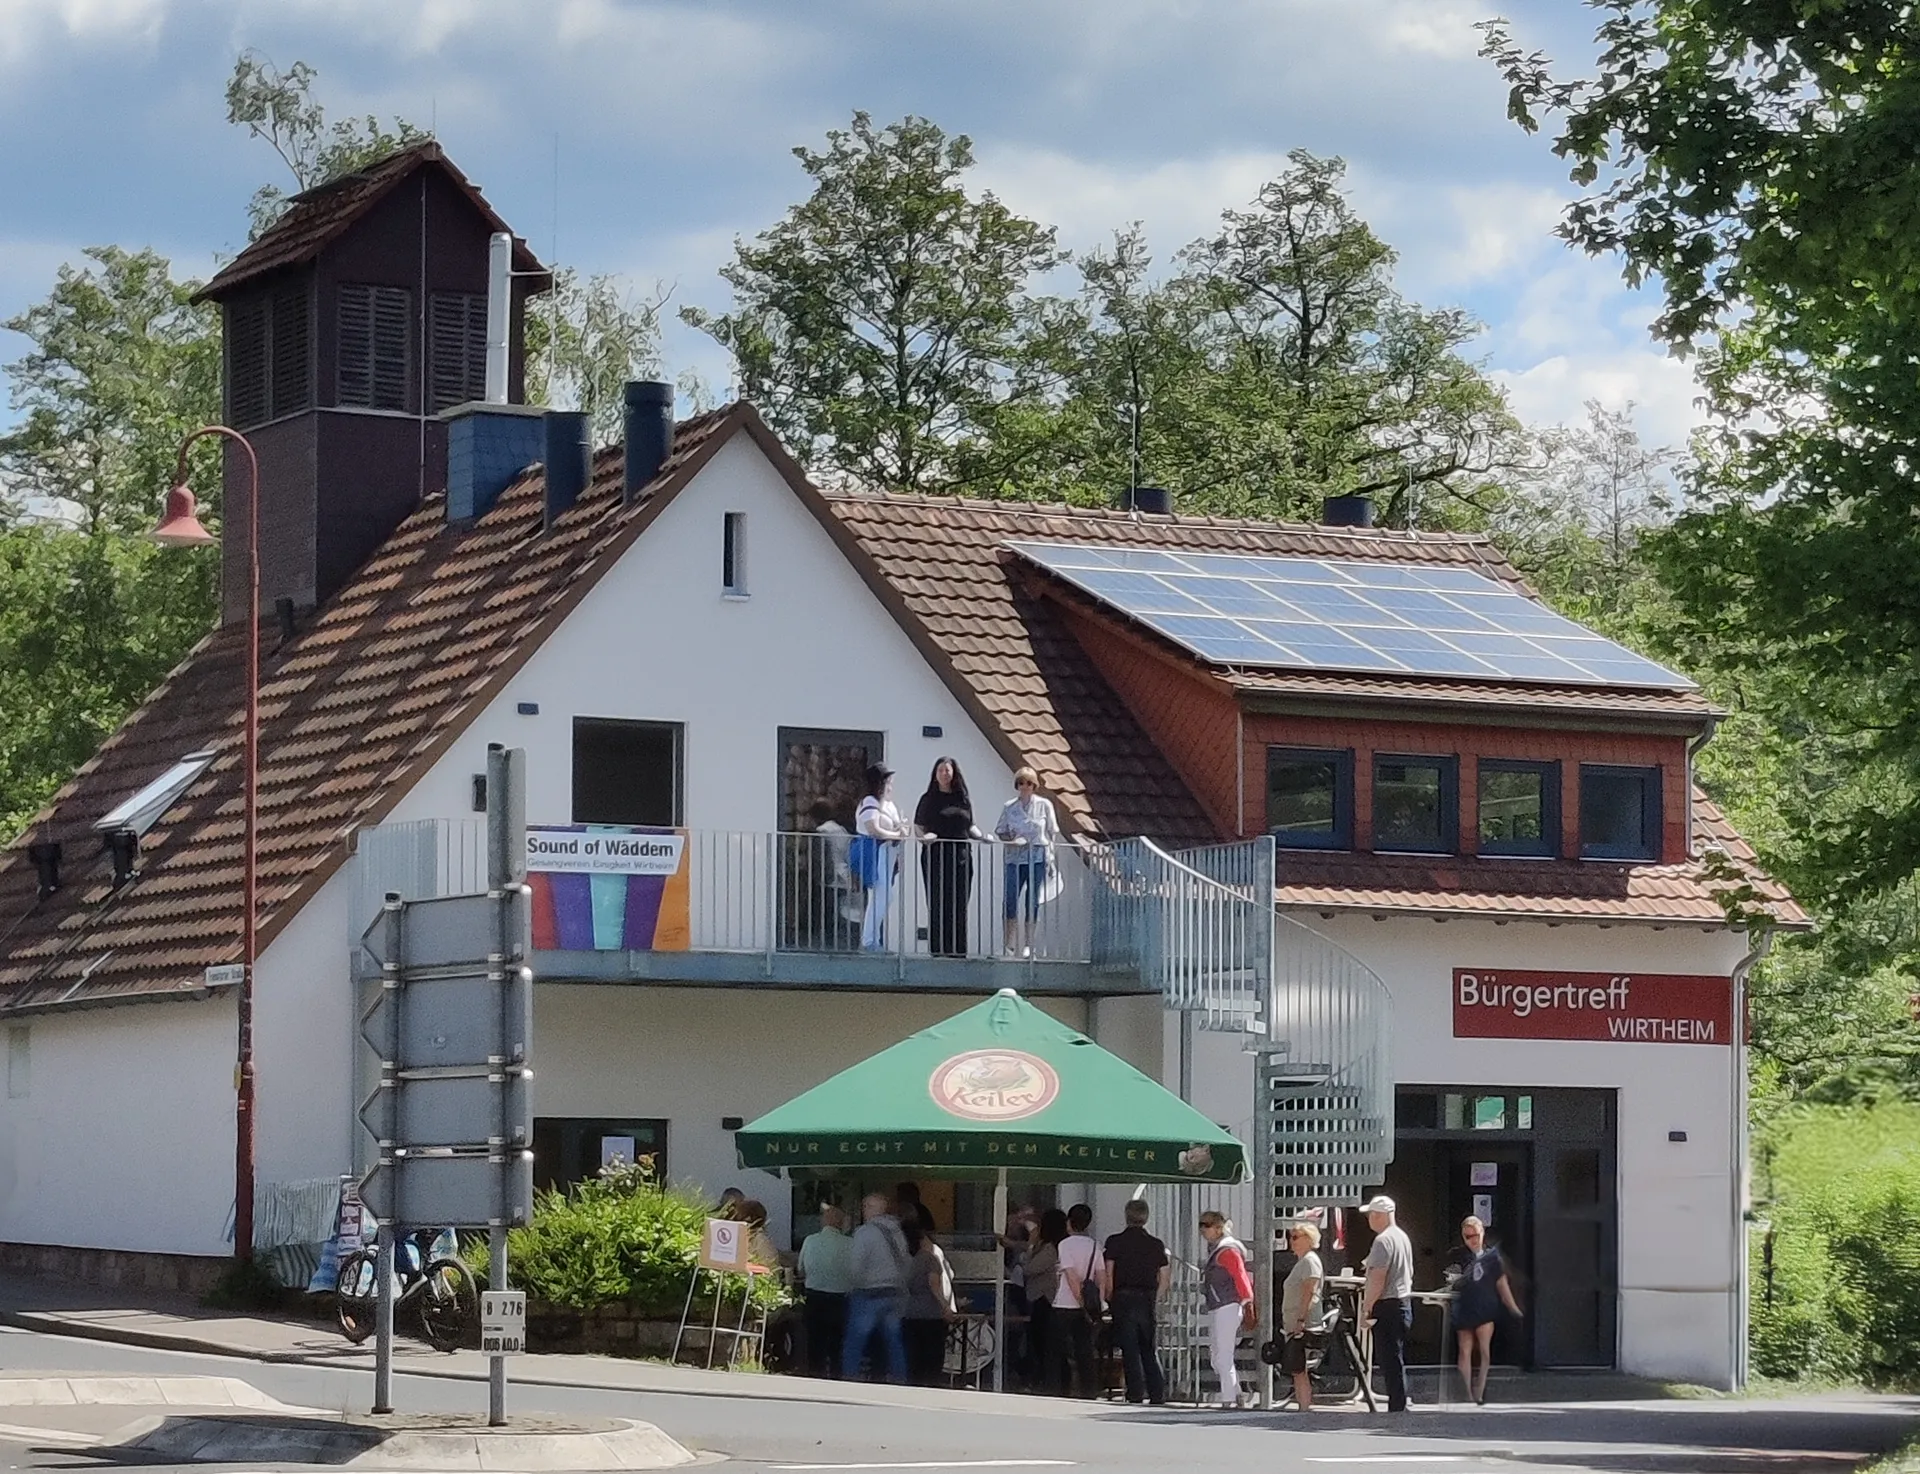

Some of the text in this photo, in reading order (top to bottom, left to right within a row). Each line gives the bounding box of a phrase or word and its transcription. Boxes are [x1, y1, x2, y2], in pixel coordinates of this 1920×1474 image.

[527, 837, 674, 857] Sound of Wäddem
[1459, 973, 1631, 1017] Bürgertreff
[1608, 1017, 1715, 1041] WIRTHEIM
[950, 1086, 1039, 1108] Keiler
[766, 1141, 1156, 1161] NUR ECHT MIT DEM KEILER
[501, 1301, 523, 1316] 276
